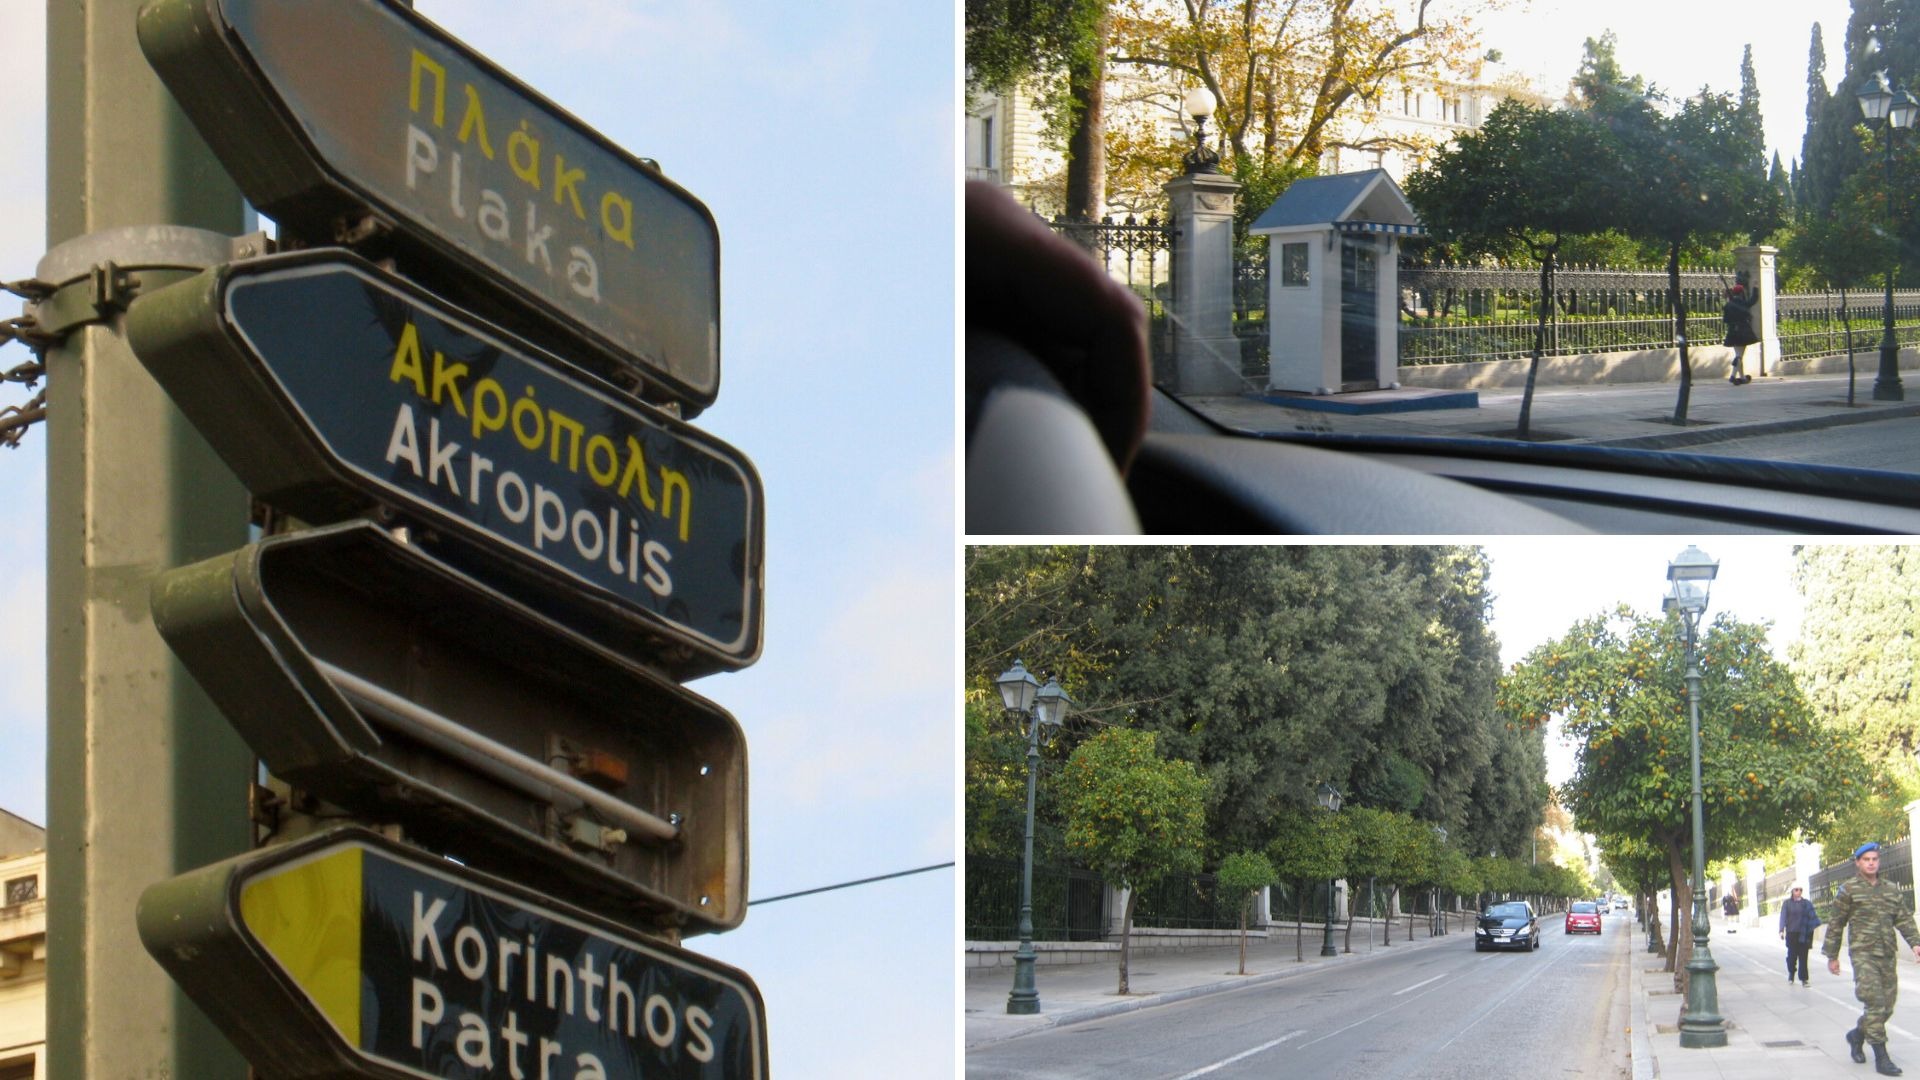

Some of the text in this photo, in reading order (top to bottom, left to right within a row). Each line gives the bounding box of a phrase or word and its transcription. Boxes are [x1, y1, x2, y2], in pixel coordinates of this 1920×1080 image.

[405, 124, 600, 303] Plaka
[408, 48, 635, 249] Πλάκα
[385, 403, 672, 597] Akropolis
[390, 322, 691, 542] Ακρόπολη
[412, 891, 714, 1063] Korinthos
